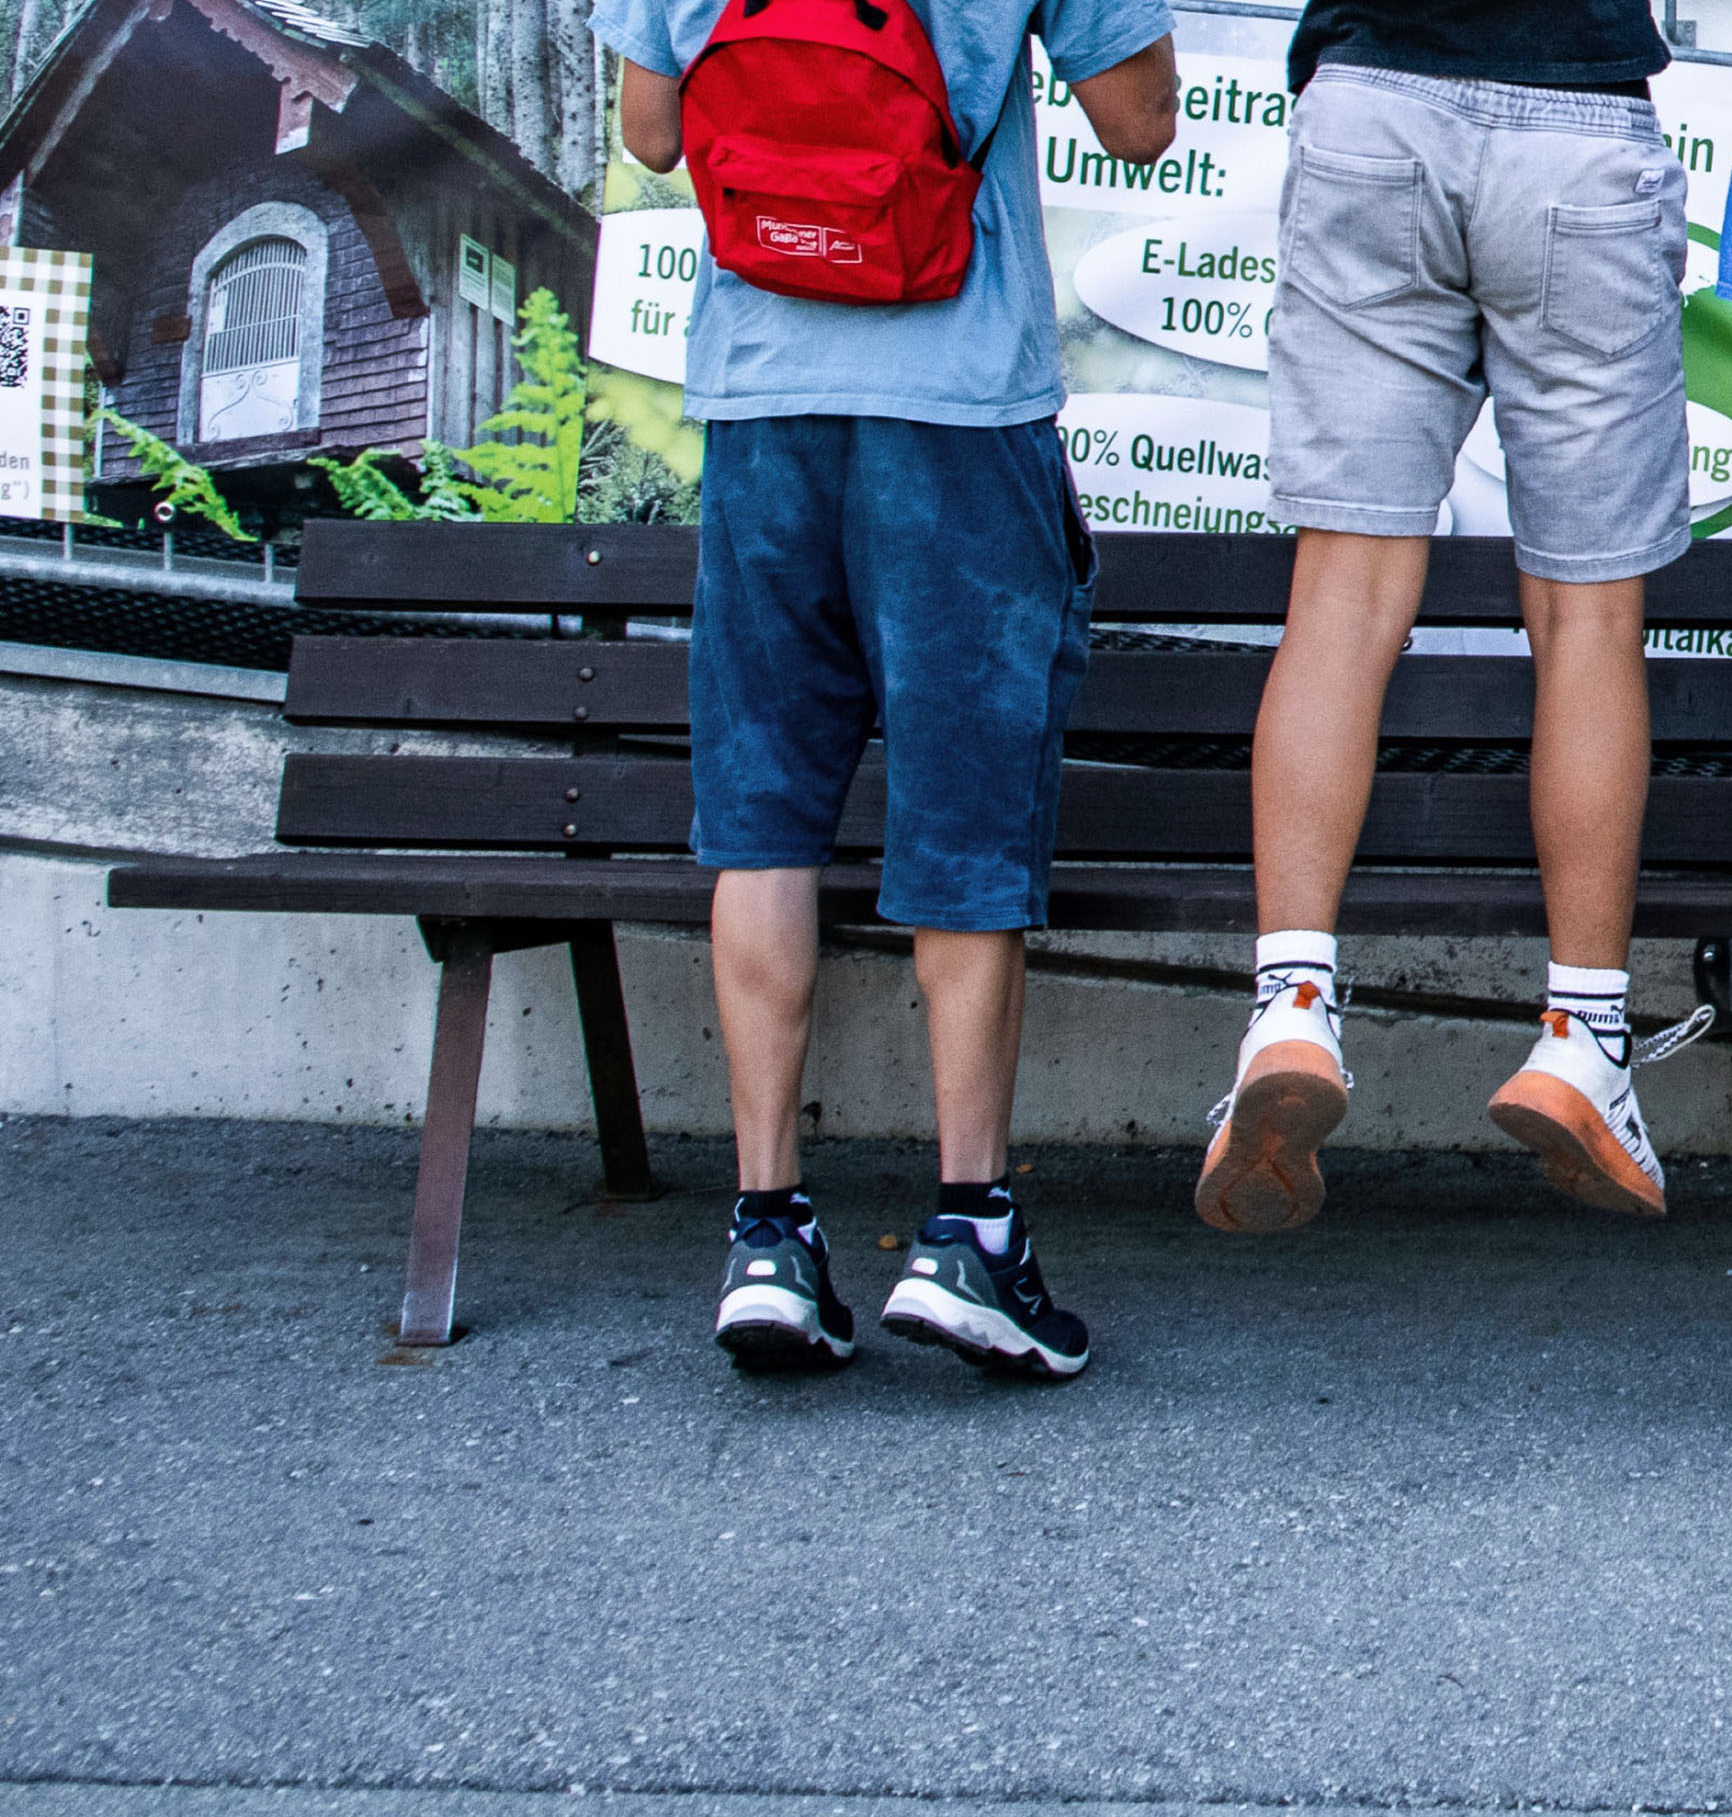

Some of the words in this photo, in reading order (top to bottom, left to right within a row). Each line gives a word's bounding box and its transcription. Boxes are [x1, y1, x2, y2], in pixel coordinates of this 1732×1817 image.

[1046, 136, 1226, 197] Umwelt:
[631, 298, 675, 336] für
[1161, 296, 1253, 338] 100%
